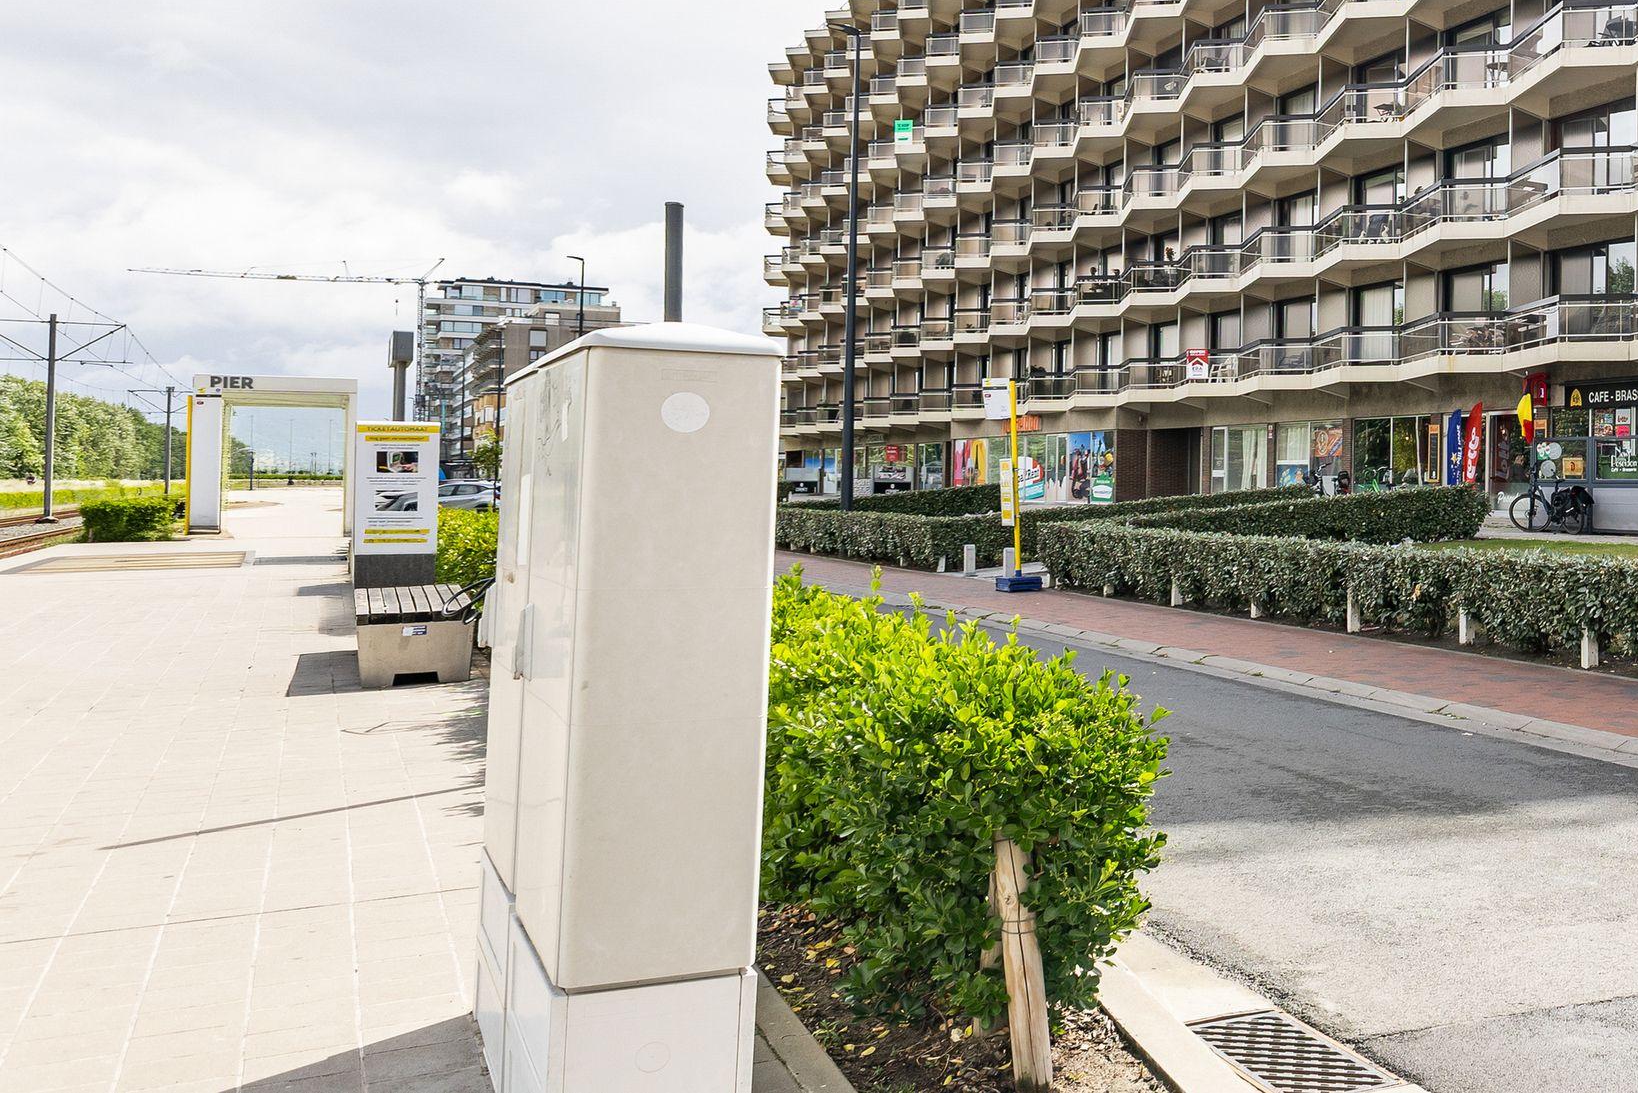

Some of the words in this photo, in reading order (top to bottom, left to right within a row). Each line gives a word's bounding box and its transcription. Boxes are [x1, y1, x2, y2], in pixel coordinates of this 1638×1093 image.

[210, 375, 254, 389] PIER
[1588, 390, 1610, 403] CAFE
[1610, 452, 1637, 468] Poseidon
